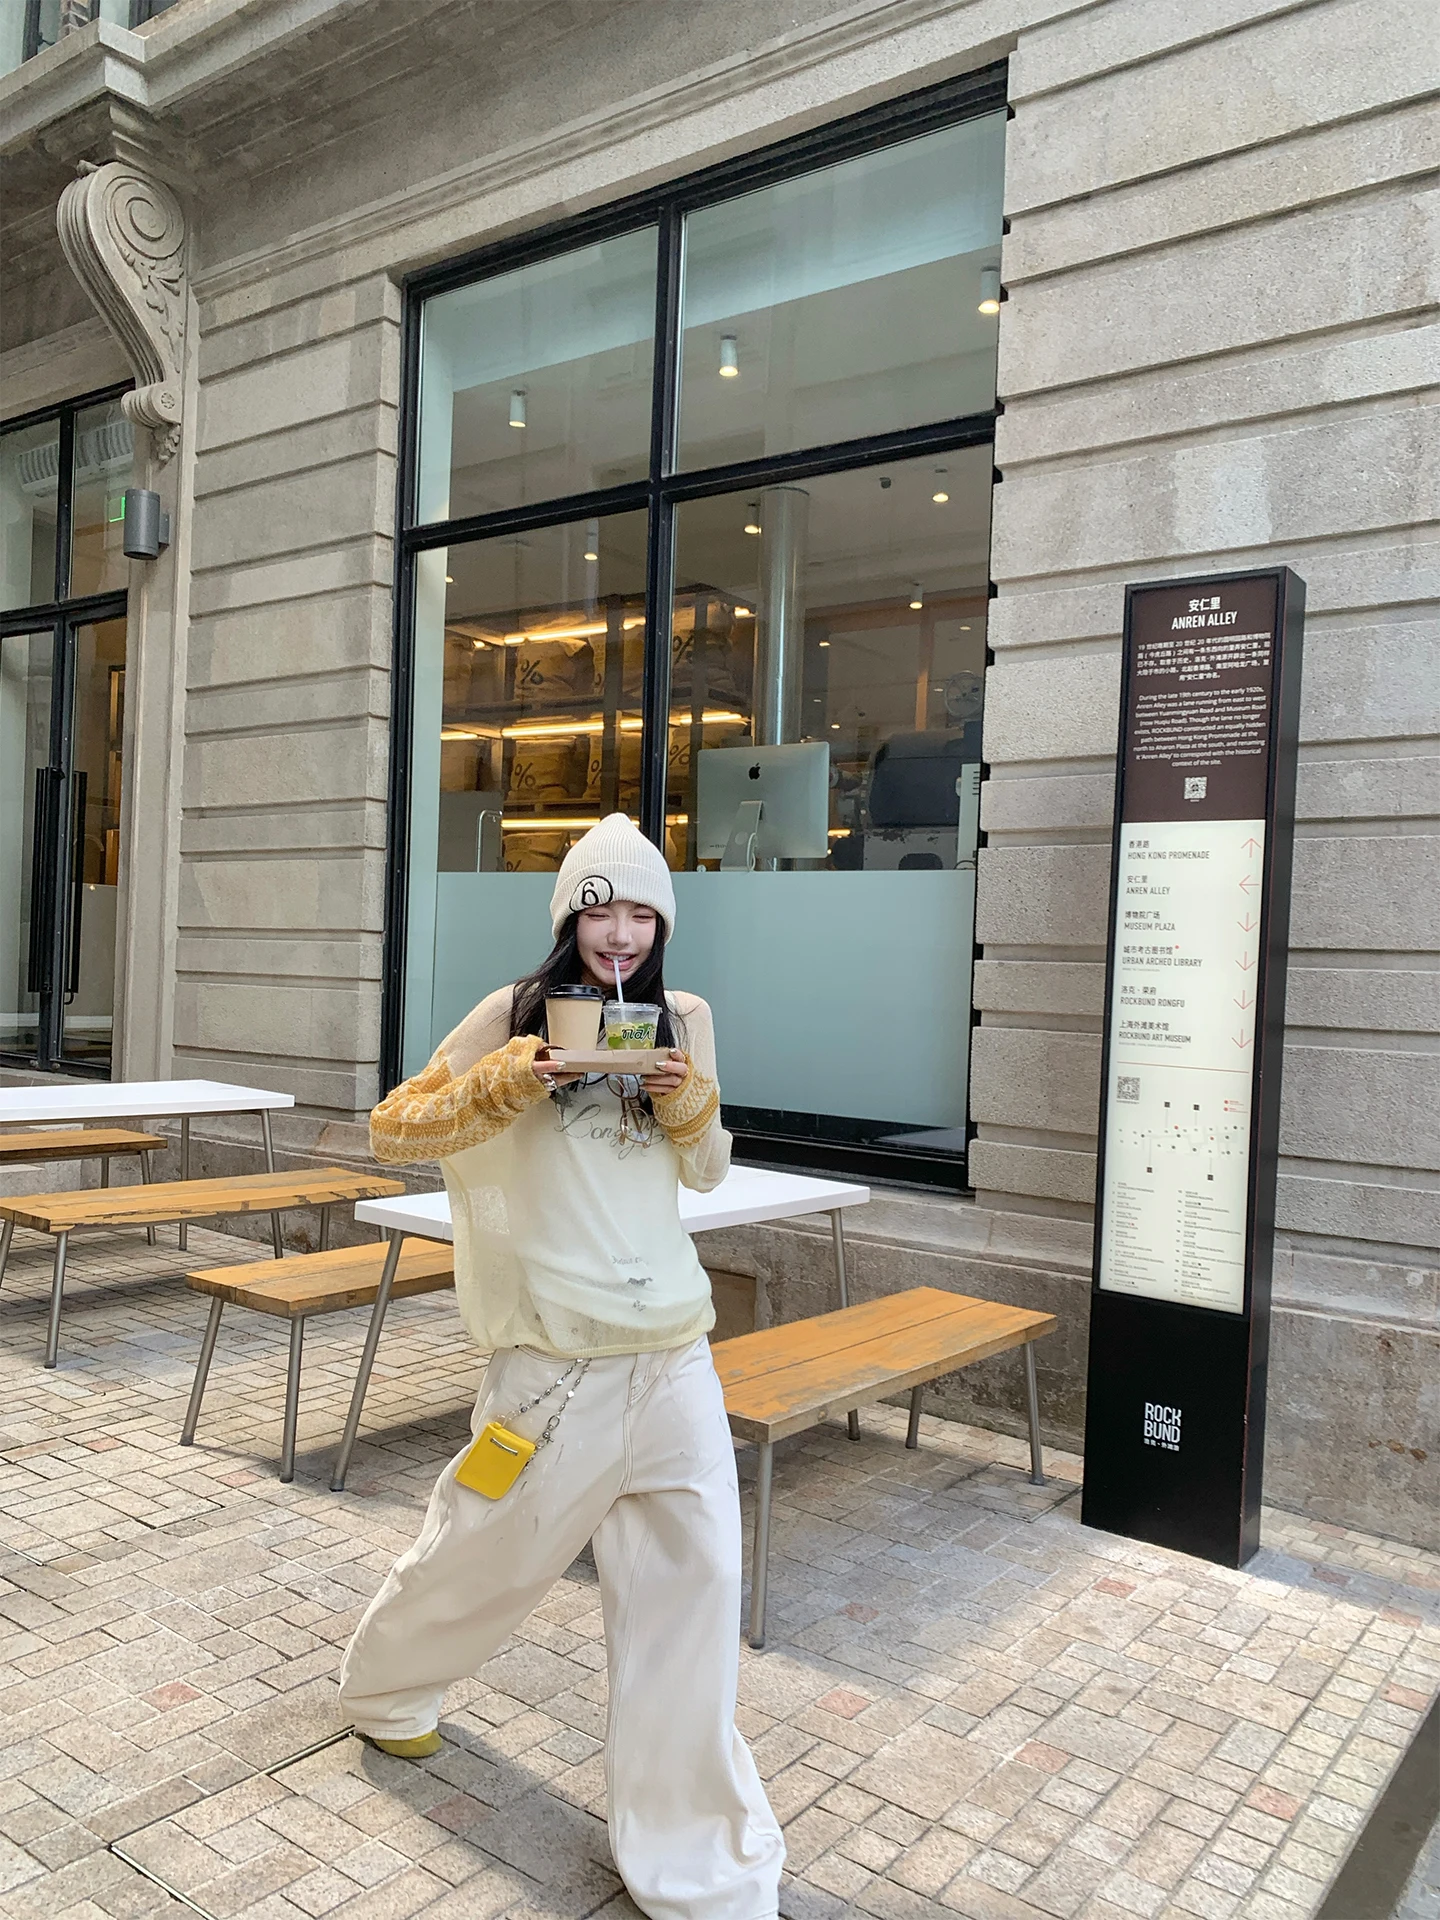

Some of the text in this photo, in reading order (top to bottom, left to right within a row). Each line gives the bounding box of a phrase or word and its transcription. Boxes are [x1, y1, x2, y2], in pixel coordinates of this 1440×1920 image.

[1189, 597, 1220, 612] 安仁里
[1172, 612, 1237, 630] ANREN ALLEY
[1148, 851, 1166, 859] KONG
[1169, 851, 1210, 859] PROMENADE
[1122, 957, 1202, 967] URBAN ARCHEO LIBRARY
[1120, 997, 1185, 1007] ROCKBUND RONGFU
[1119, 1031, 1191, 1043] ROCKBUND ART MUSEUM
[1145, 1402, 1181, 1426] ROCK
[1144, 1420, 1180, 1443] BUND
